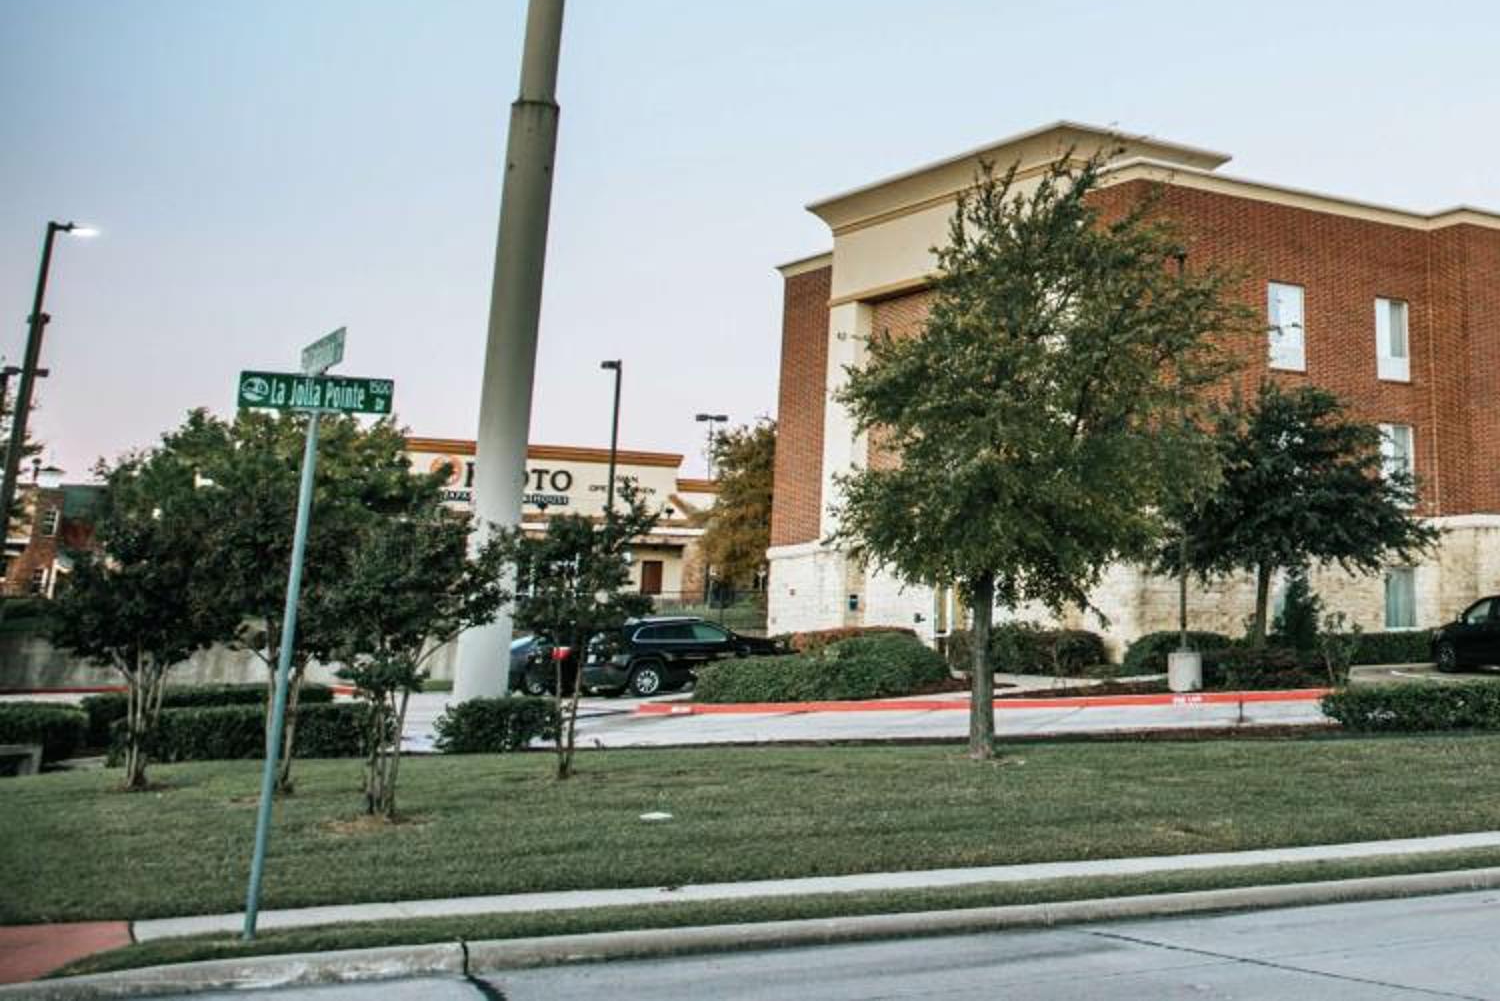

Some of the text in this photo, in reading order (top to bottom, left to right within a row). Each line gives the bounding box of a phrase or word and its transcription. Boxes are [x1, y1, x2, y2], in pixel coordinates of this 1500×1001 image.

[271, 378, 366, 410] La Jolla Pointe
